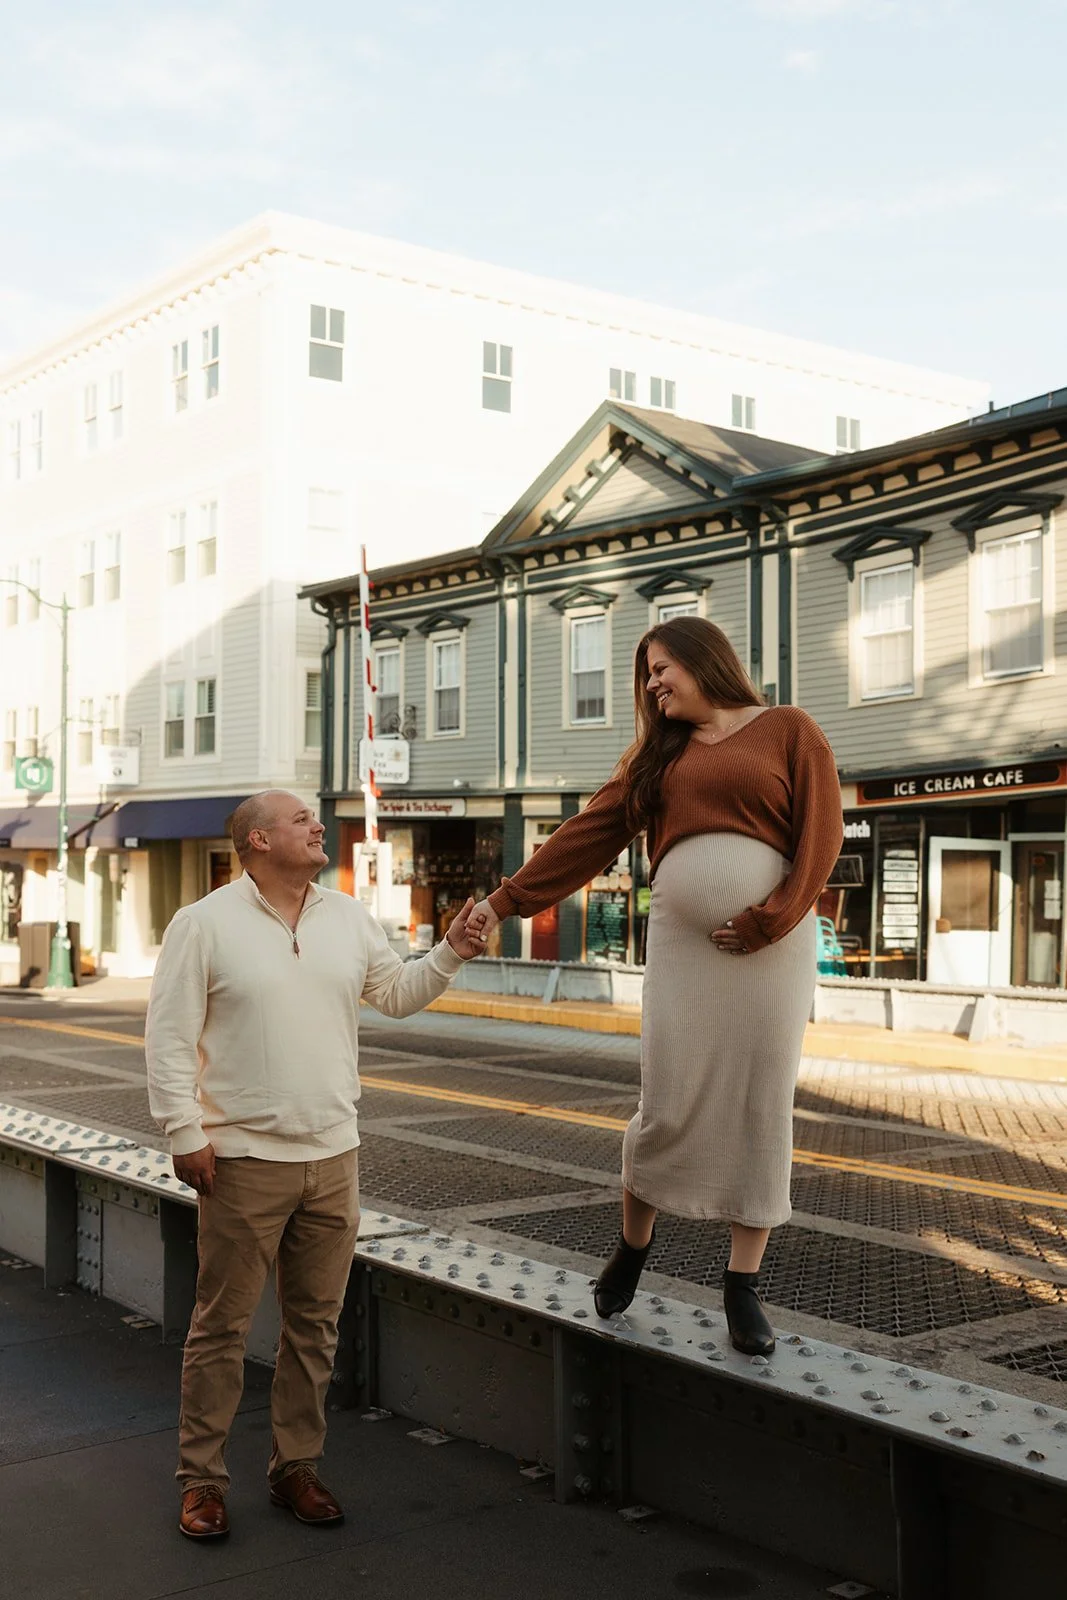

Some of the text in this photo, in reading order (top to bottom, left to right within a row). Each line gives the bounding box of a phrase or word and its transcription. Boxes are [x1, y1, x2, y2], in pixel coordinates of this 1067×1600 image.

[893, 770, 1024, 796] ICE CREAM CAFE
[378, 802, 452, 816] The Spice & Tea Exchange
[843, 820, 871, 839] atch
